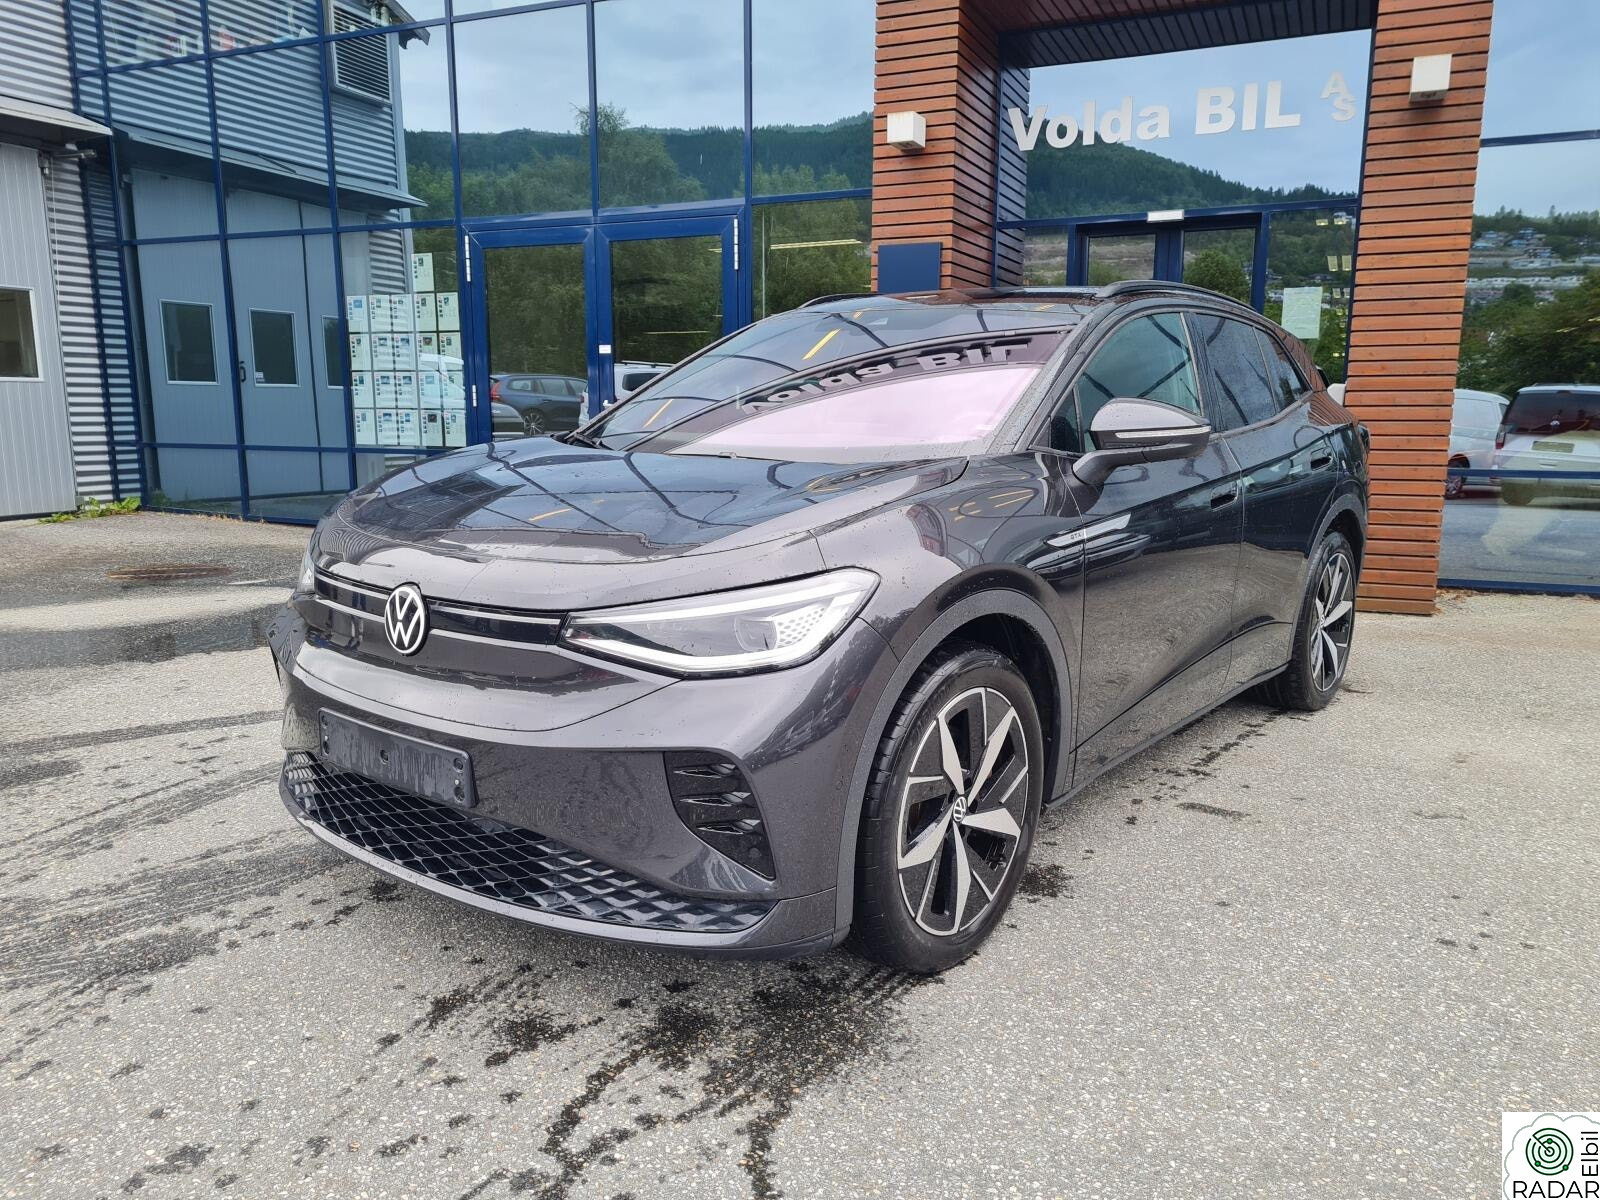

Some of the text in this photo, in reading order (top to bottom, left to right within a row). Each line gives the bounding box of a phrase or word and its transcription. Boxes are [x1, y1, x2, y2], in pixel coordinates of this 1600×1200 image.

[1007, 96, 1171, 152] Volda
[1194, 80, 1301, 136] BIL
[386, 587, 424, 653] VW
